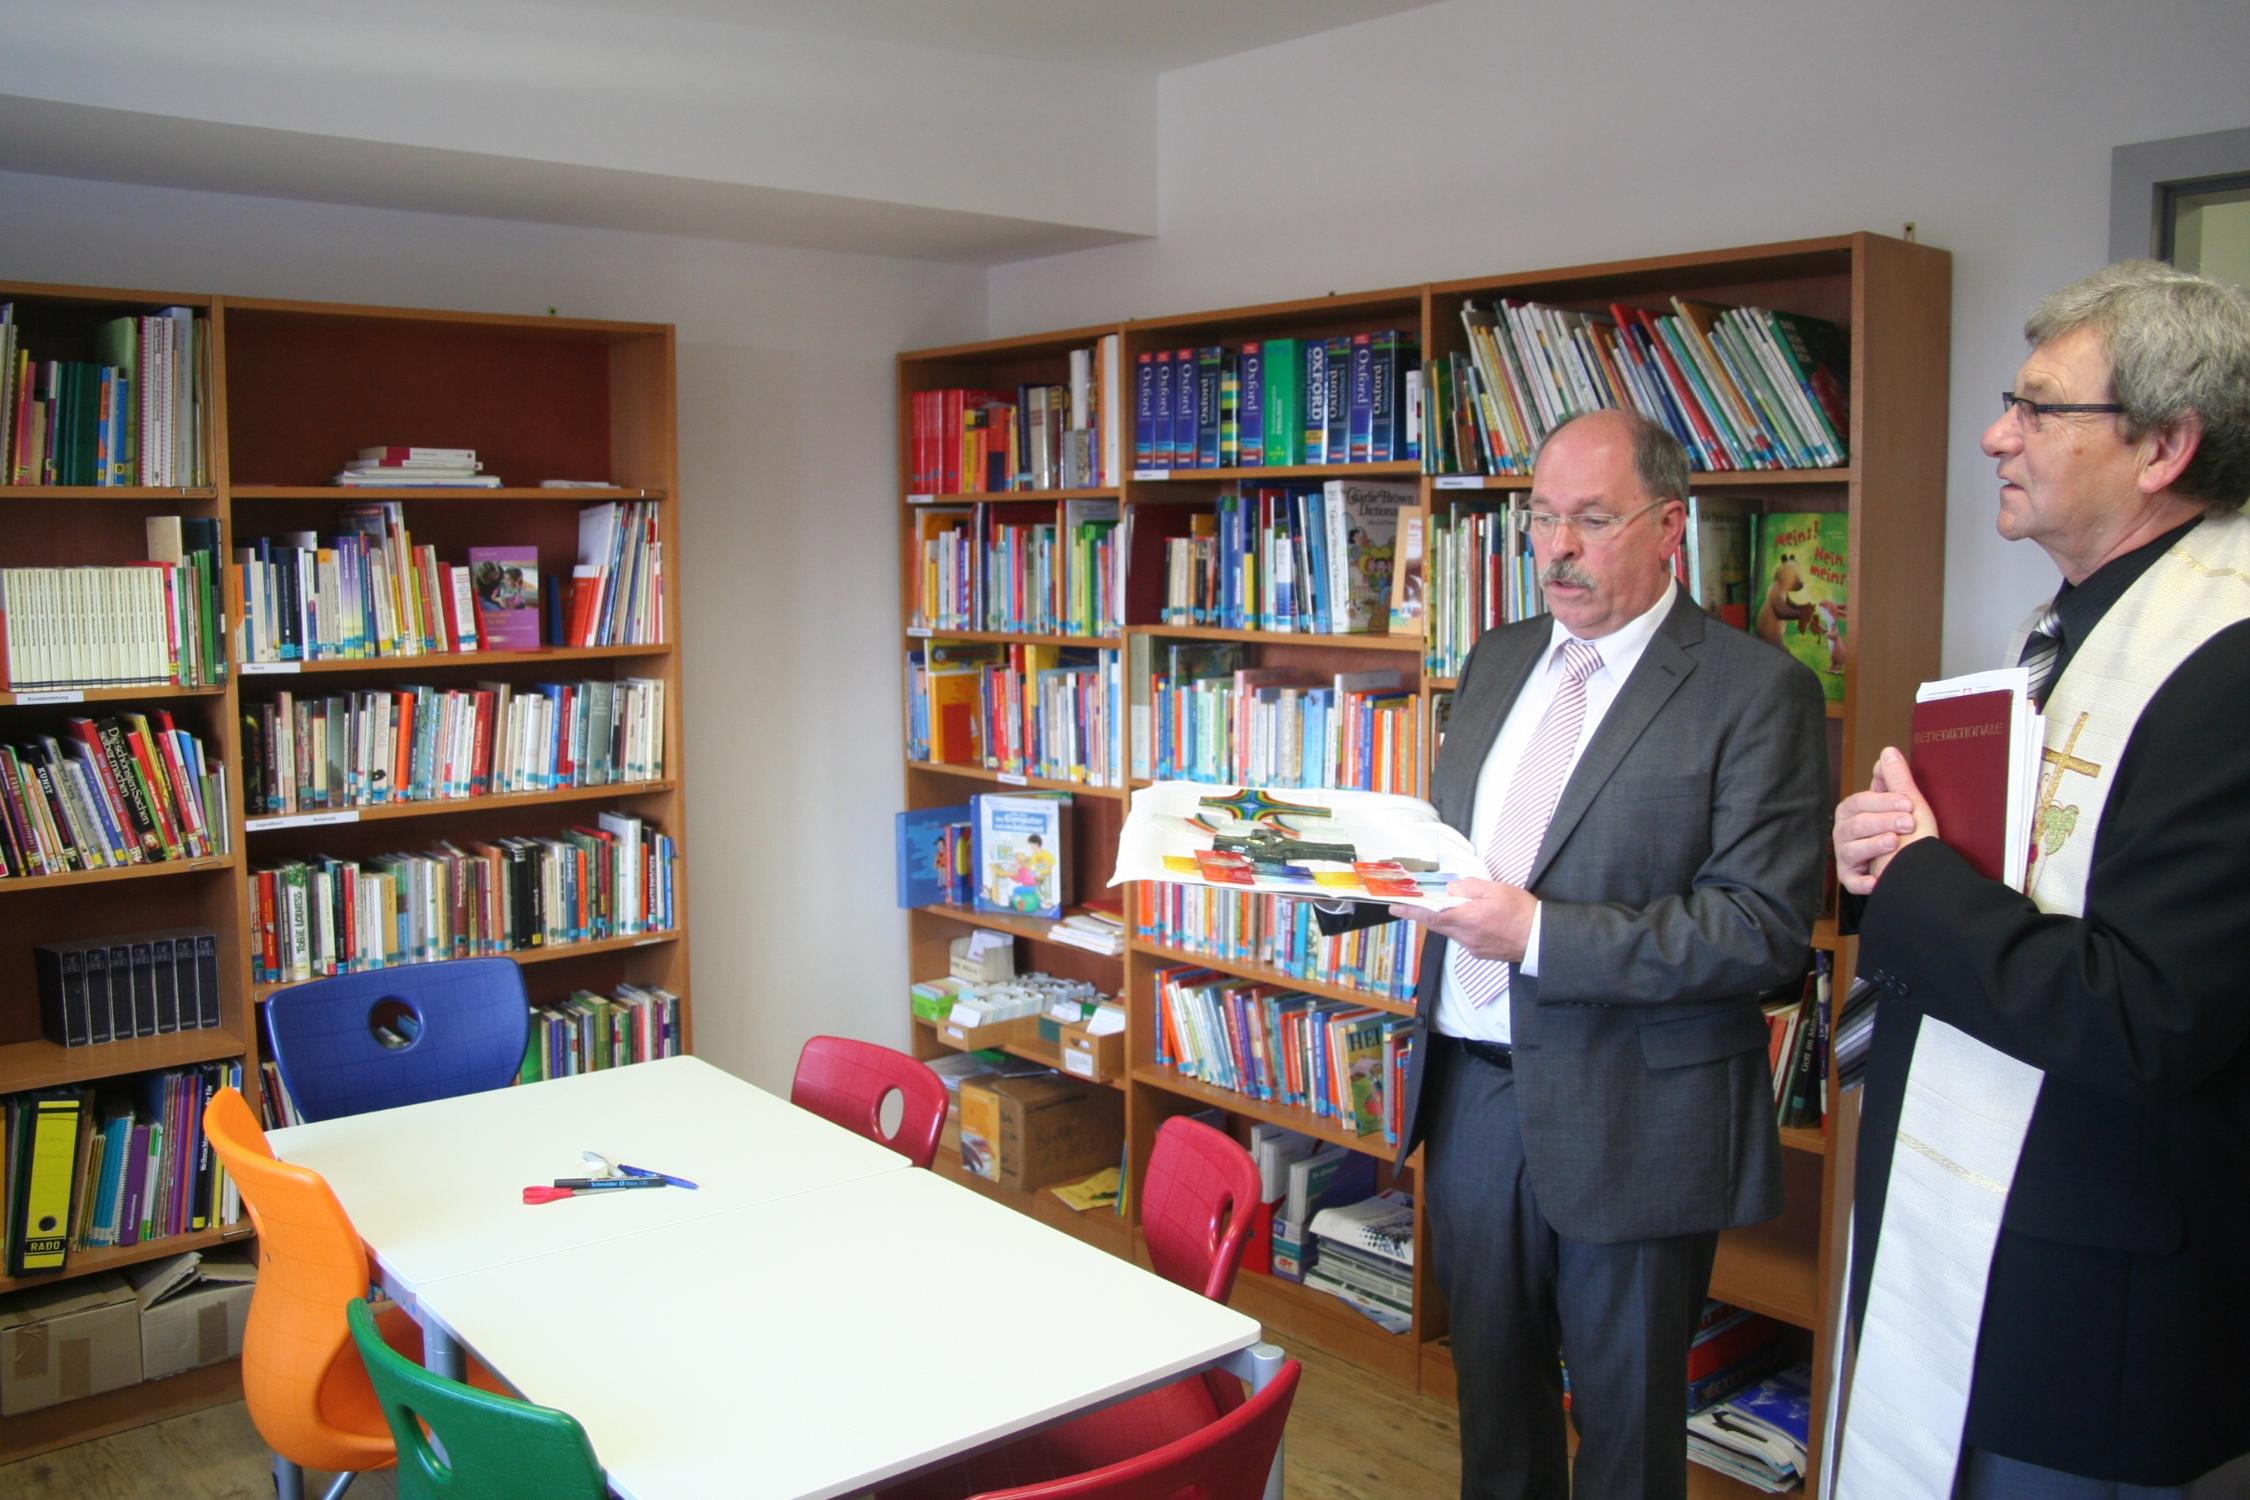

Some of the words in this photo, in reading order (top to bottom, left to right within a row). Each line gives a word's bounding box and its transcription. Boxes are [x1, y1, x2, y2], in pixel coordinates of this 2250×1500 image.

[1142, 366, 1152, 417] Oxford
[1160, 366, 1170, 417] Oxford
[1182, 364, 1192, 415] Oxford
[1247, 358, 1259, 411] Oxford
[1311, 346, 1323, 421] OXFORD
[1358, 349, 1370, 404] Oxford
[37, 766, 54, 795] KUNST
[132, 789, 150, 825] Sachen
[30, 1240, 60, 1251] RADO
